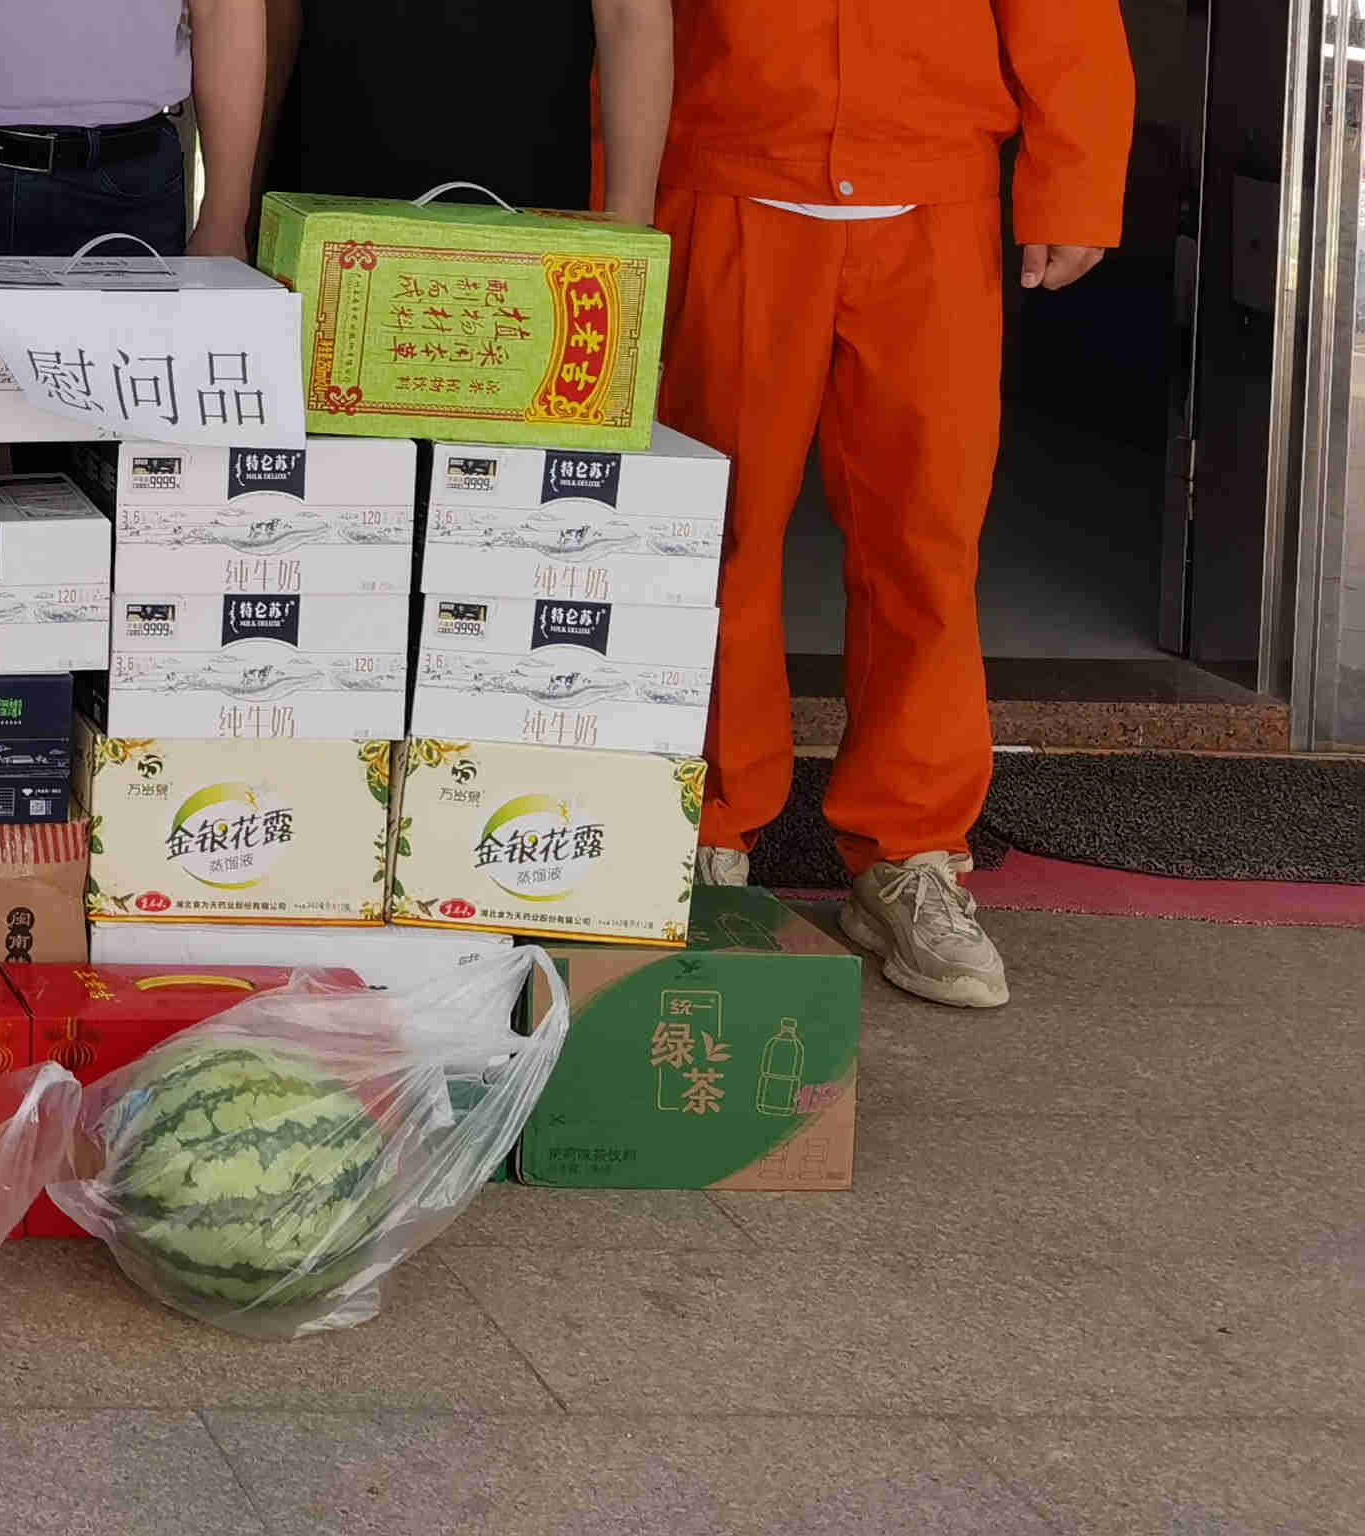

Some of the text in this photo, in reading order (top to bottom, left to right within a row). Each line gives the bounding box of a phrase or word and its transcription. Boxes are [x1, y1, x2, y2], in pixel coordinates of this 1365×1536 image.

[560, 291, 602, 391] 王老吉
[27, 349, 265, 425] 慰问品
[246, 453, 288, 472] 特仑苏
[560, 459, 602, 480] 特仑苏
[149, 475, 177, 490] 9999
[463, 476, 491, 491] 9999
[226, 558, 304, 591] 纯牛奶
[533, 564, 611, 599] 纯牛奶
[240, 601, 282, 620] 特仑苏
[551, 606, 593, 627] 特仑苏
[143, 622, 171, 638] 9999
[453, 620, 481, 637] 9999
[219, 705, 297, 738] 纯牛奶
[522, 709, 600, 746] 纯牛奶
[166, 808, 293, 860] 金银花露
[475, 824, 604, 868] 金银花露
[670, 999, 713, 1015] 统一
